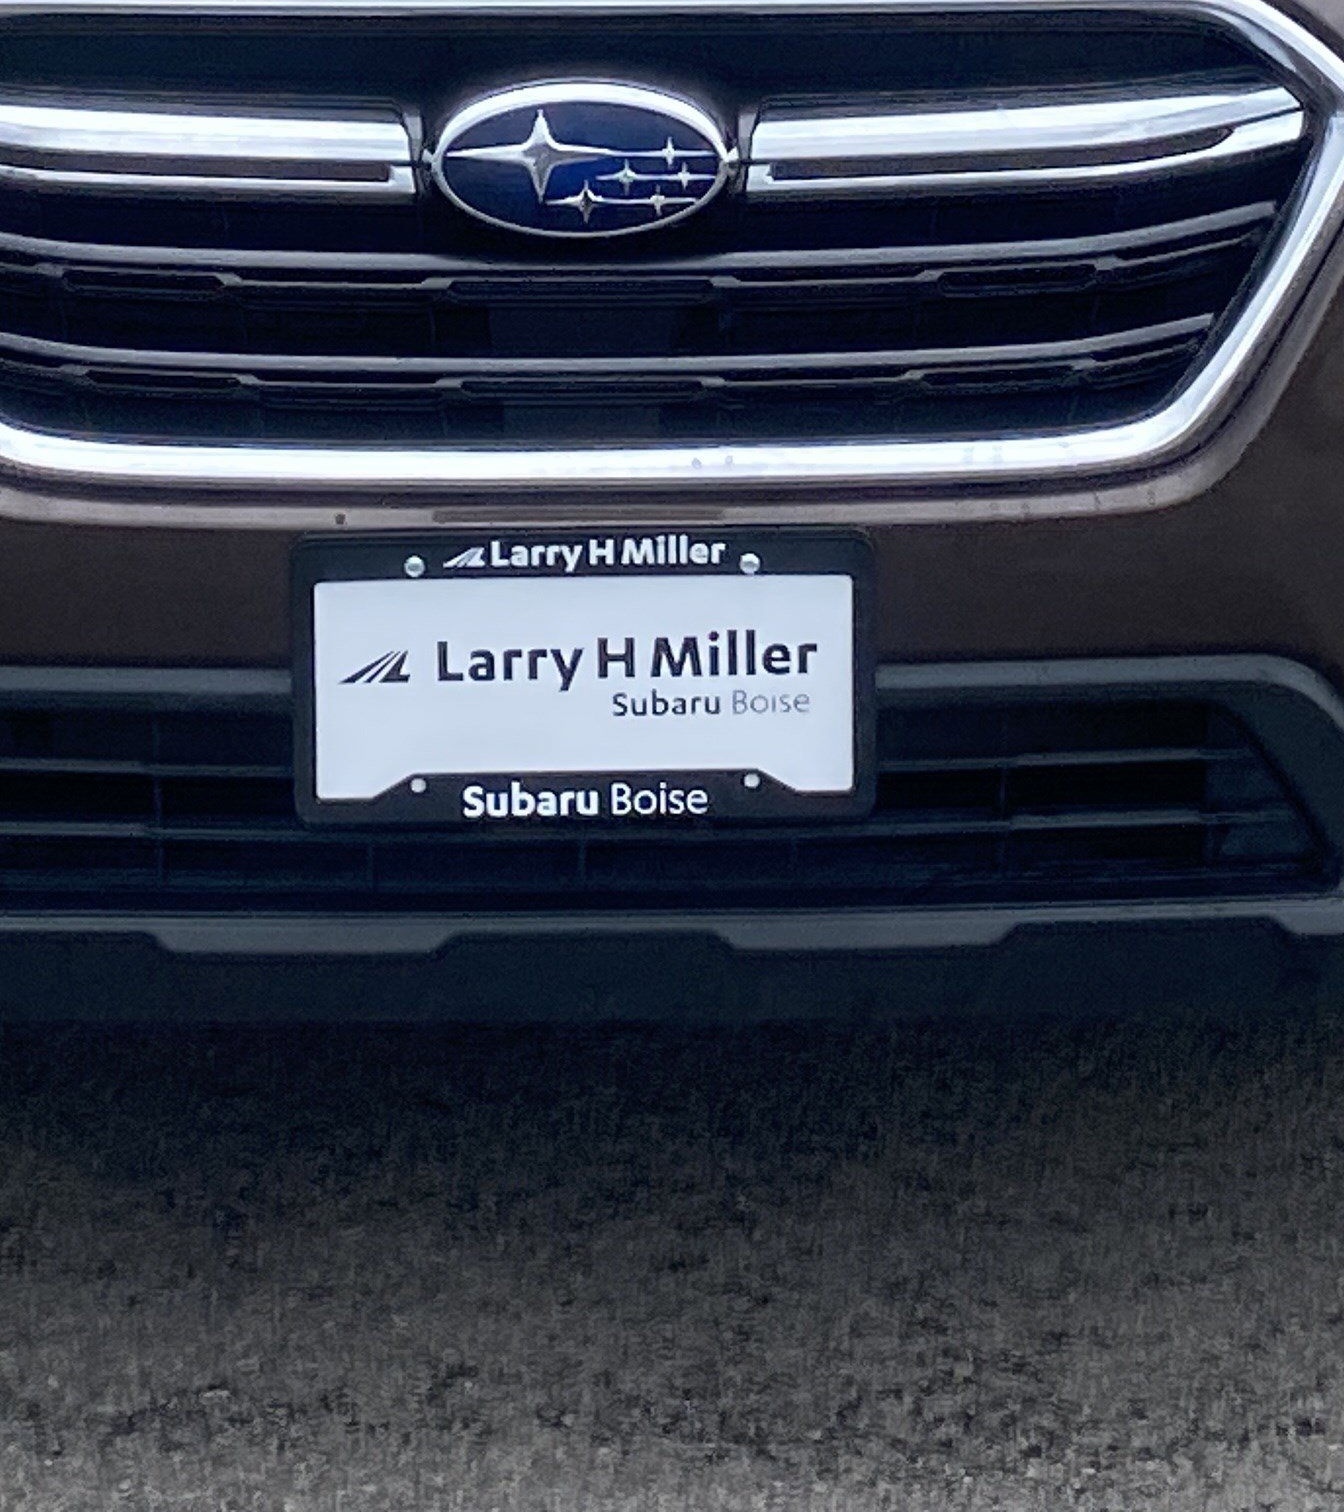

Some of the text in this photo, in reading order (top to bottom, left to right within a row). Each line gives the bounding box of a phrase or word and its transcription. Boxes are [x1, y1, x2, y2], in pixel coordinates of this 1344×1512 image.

[491, 534, 726, 573] Larry H Miller
[437, 629, 818, 692] Larry H Miller
[611, 687, 810, 718] Subaru Boise
[463, 781, 708, 818] Subaru Boise
